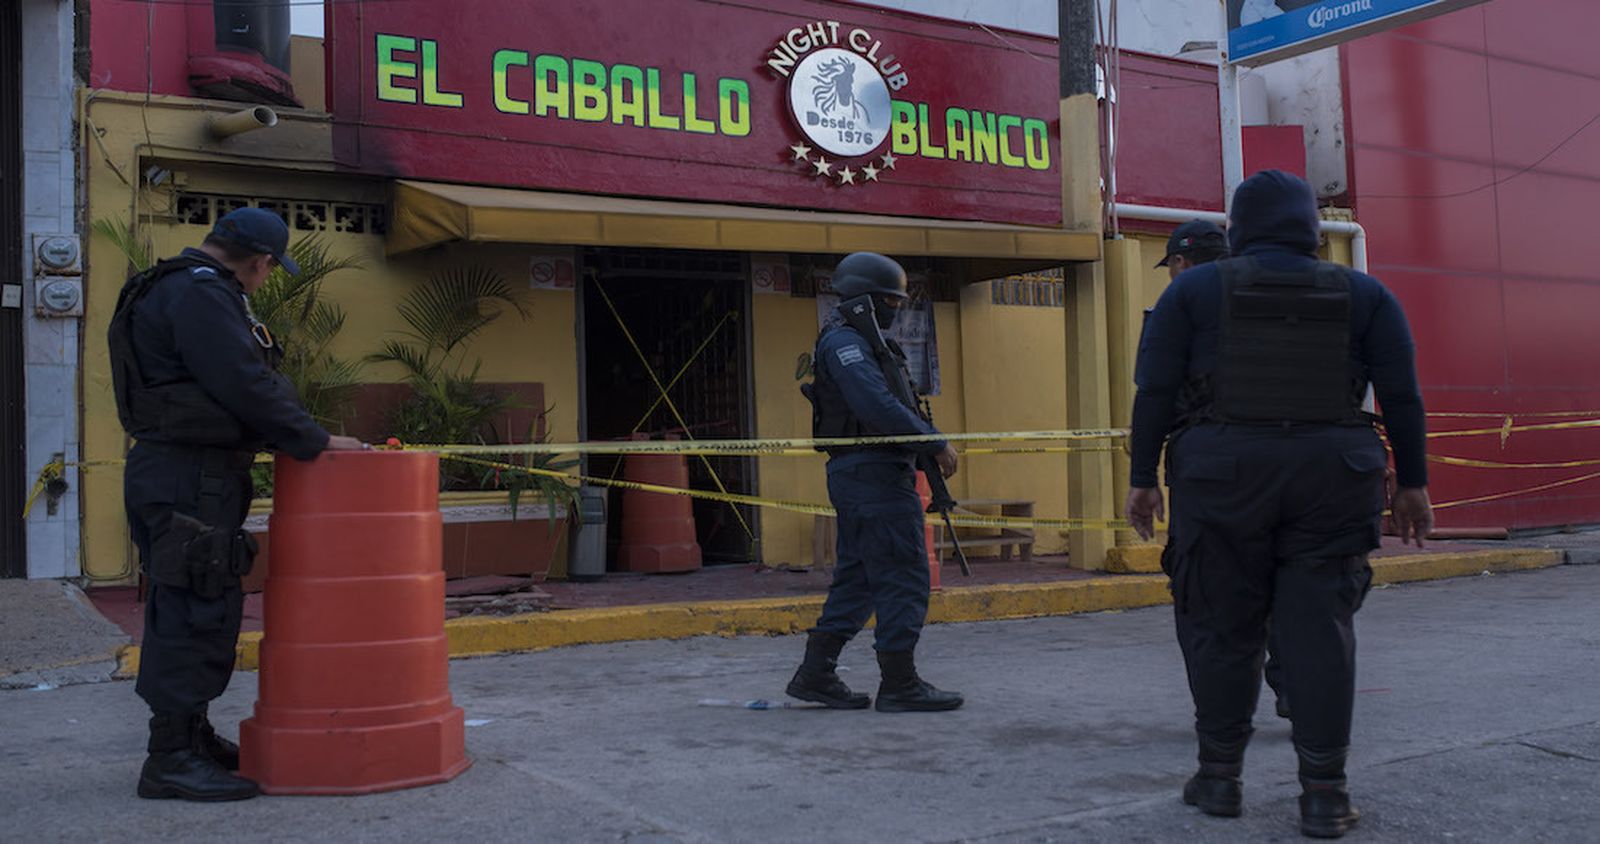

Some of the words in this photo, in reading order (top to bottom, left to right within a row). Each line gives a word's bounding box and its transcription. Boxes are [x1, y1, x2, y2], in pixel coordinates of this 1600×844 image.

[1307, 0, 1372, 29] Corona
[767, 21, 840, 77] NIGHT
[849, 28, 909, 92] CLUB
[375, 33, 463, 108] EL
[492, 49, 751, 137] CABALLO
[891, 99, 1051, 170] BLANCO
[806, 111, 855, 131] Desde
[838, 131, 874, 146] 1976
